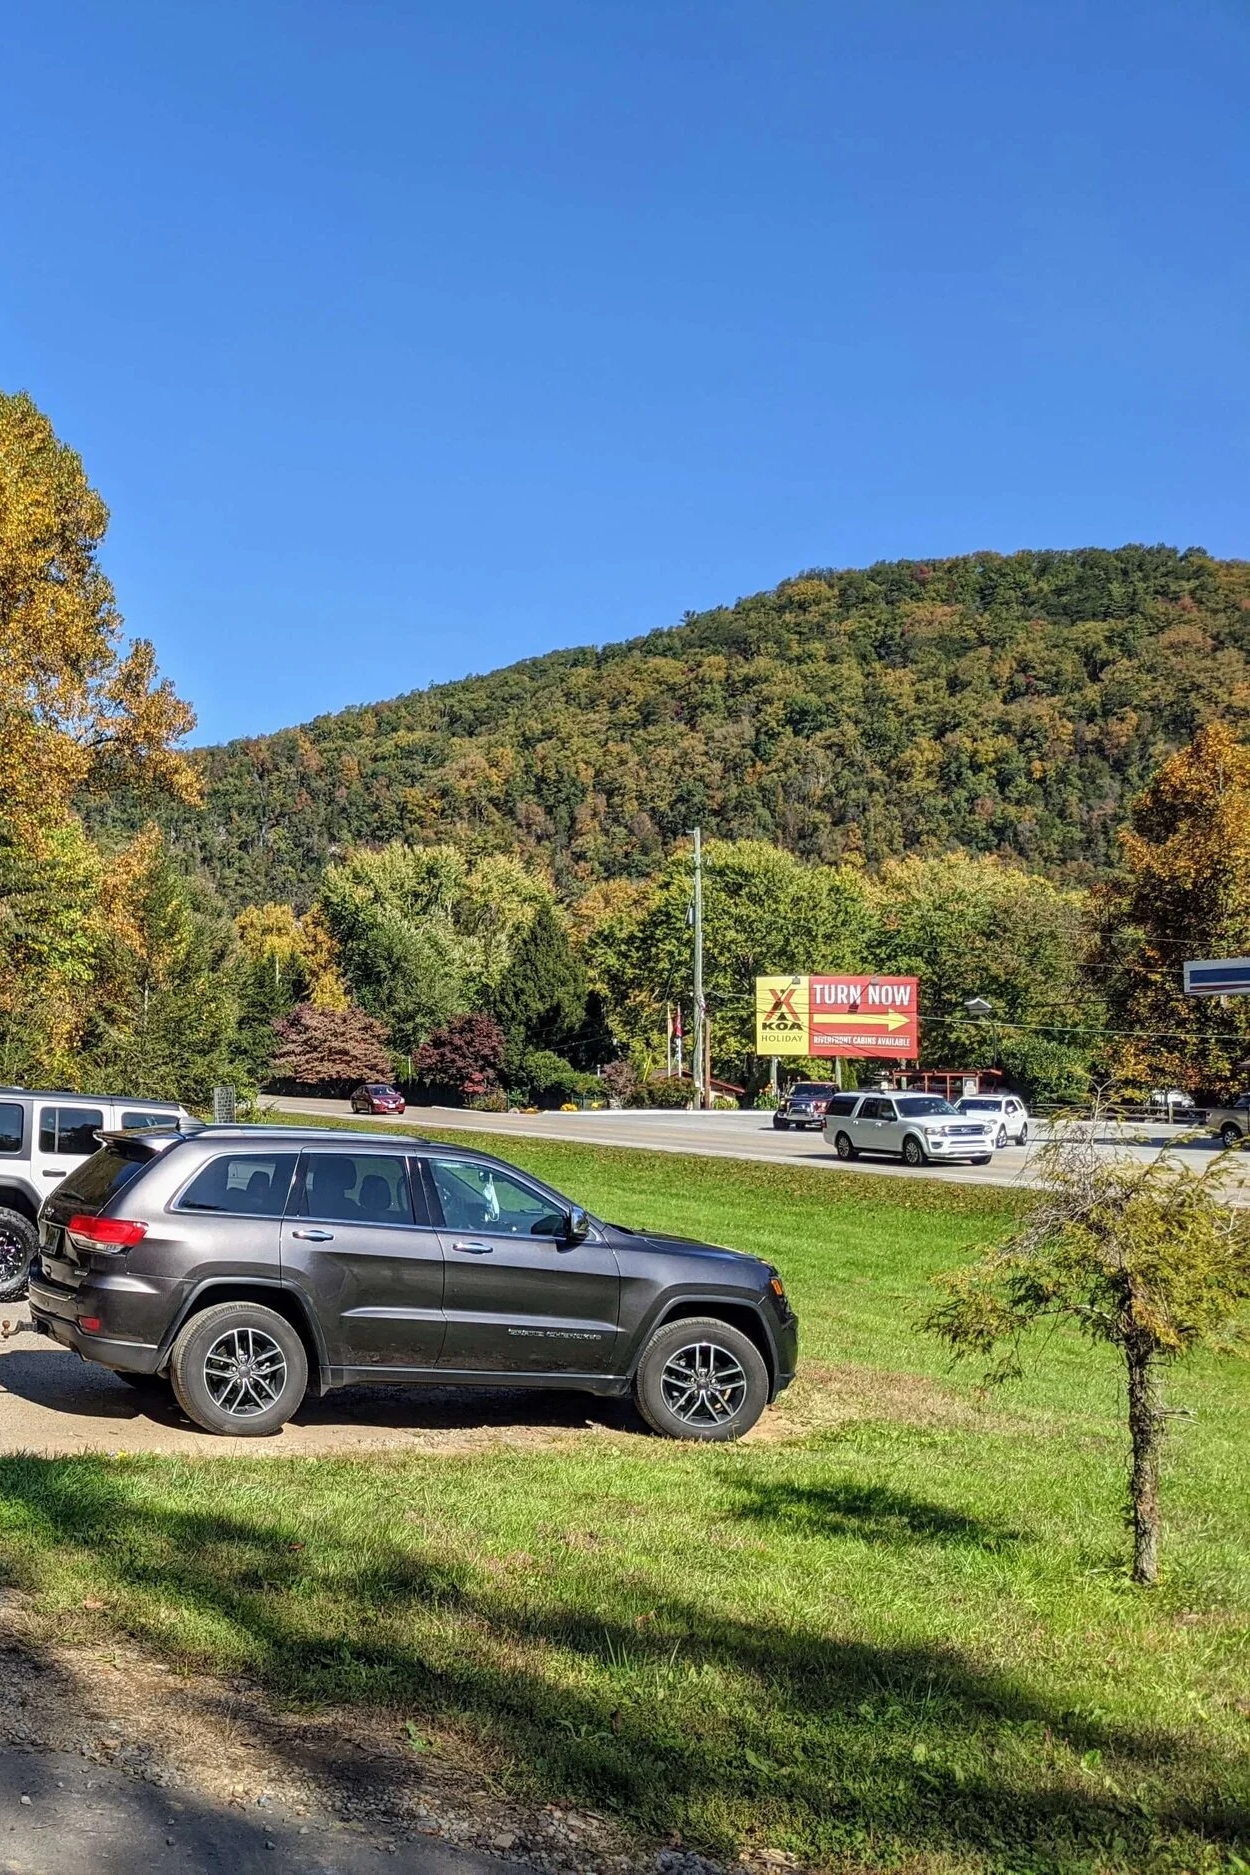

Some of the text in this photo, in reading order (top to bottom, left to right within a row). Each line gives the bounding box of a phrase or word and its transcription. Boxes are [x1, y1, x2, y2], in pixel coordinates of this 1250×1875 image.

[813, 984, 911, 1006] TURN NOW
[761, 1022, 803, 1031] KOA
[813, 1036, 911, 1046] RIVERFRONT CABINS AVAILABLE
